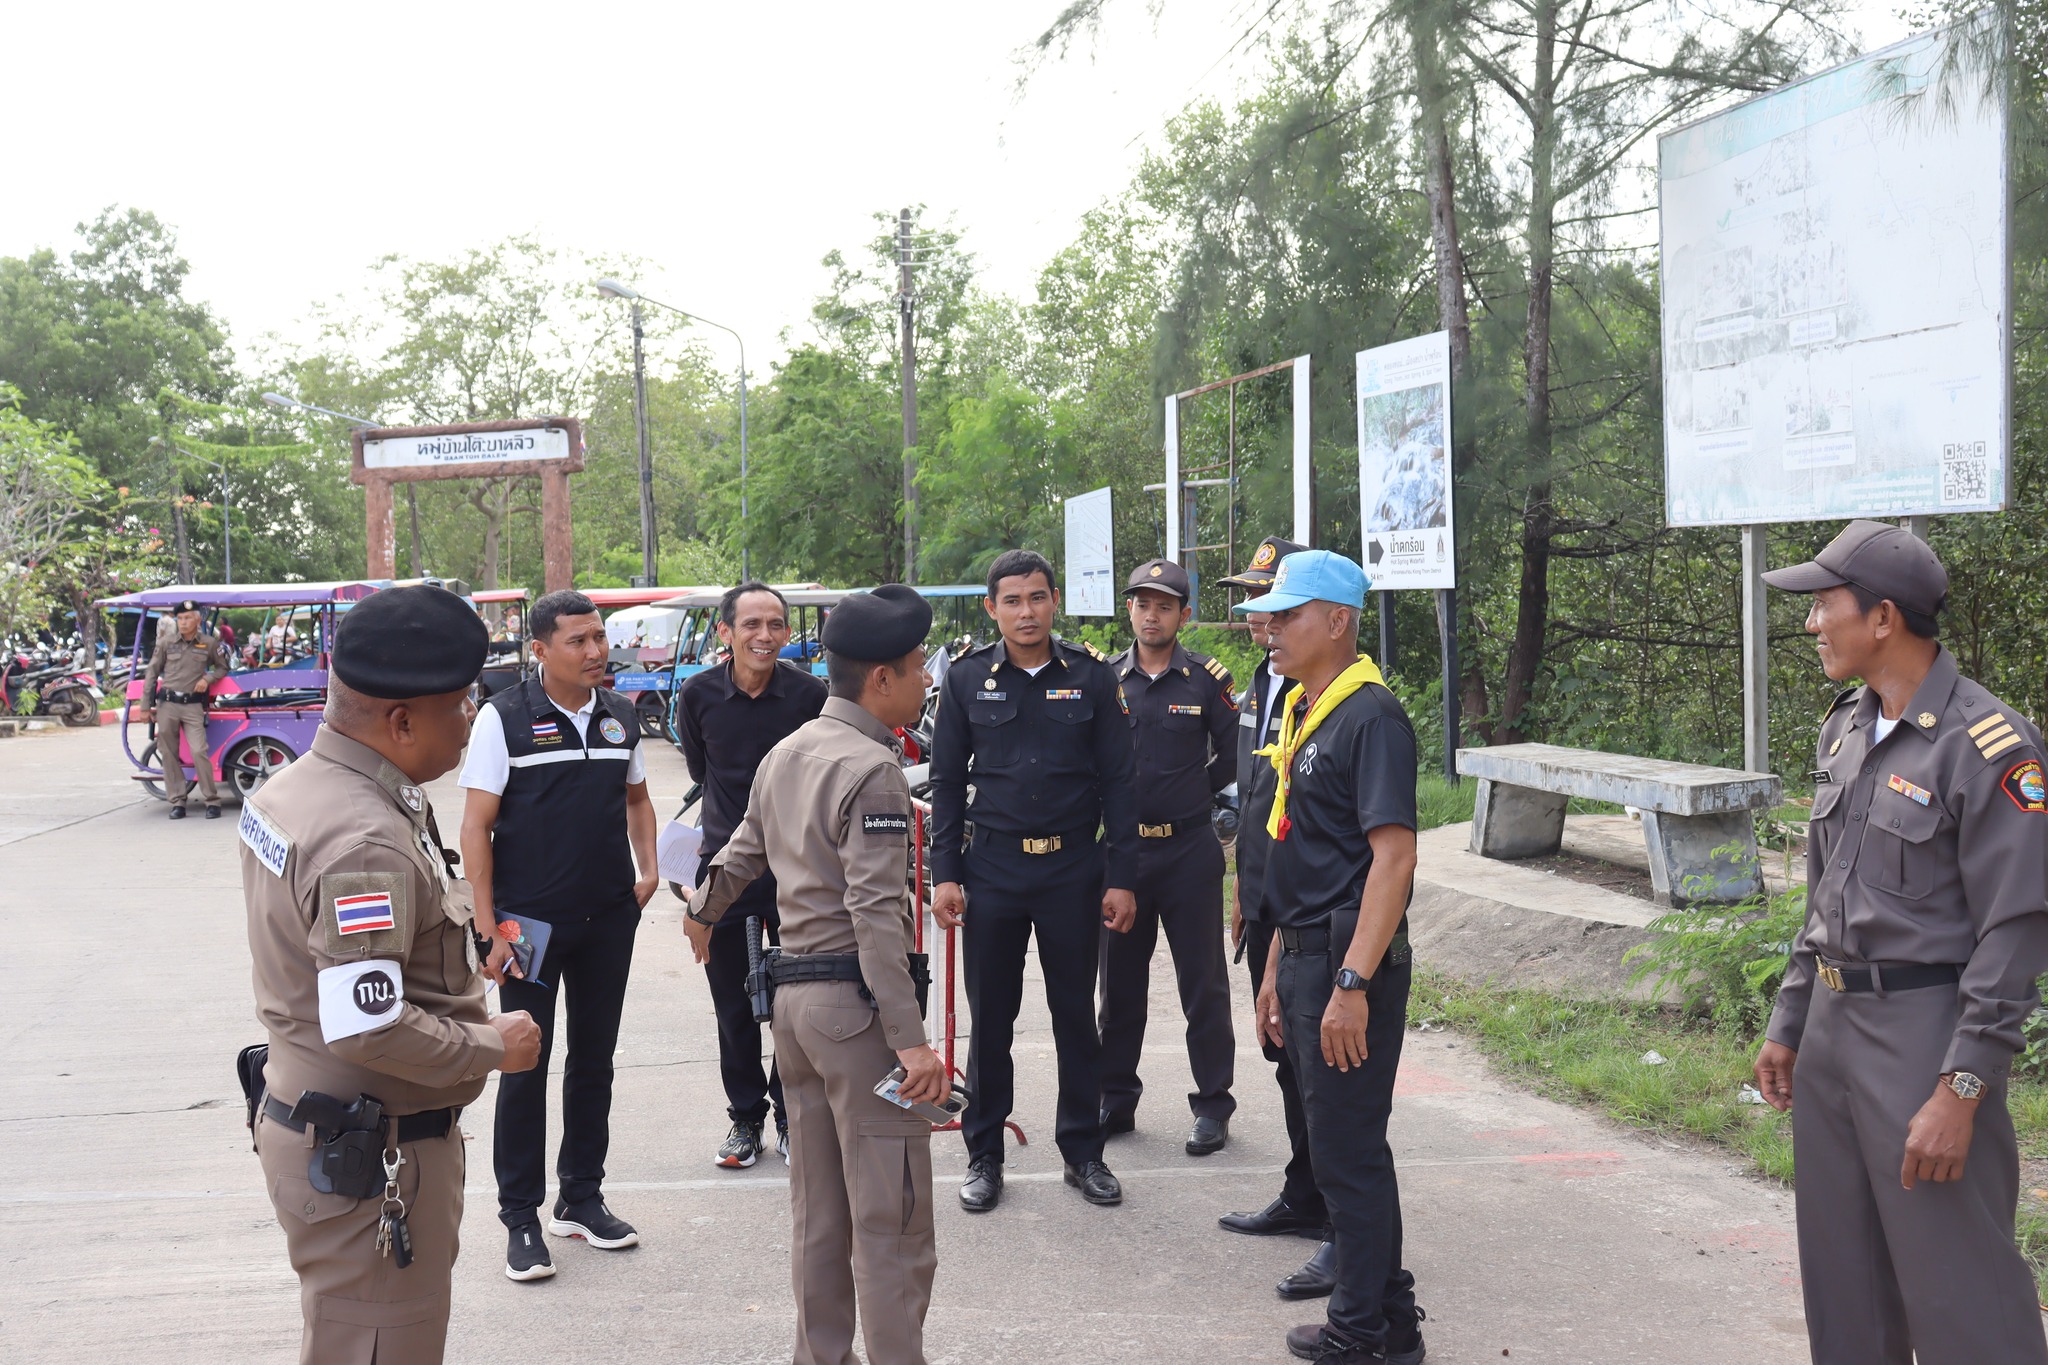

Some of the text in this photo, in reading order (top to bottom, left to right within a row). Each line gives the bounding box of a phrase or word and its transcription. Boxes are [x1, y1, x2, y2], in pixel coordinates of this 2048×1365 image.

[1390, 534, 1425, 553] น้ำตกร้อน
[258, 830, 286, 869] POLICE
